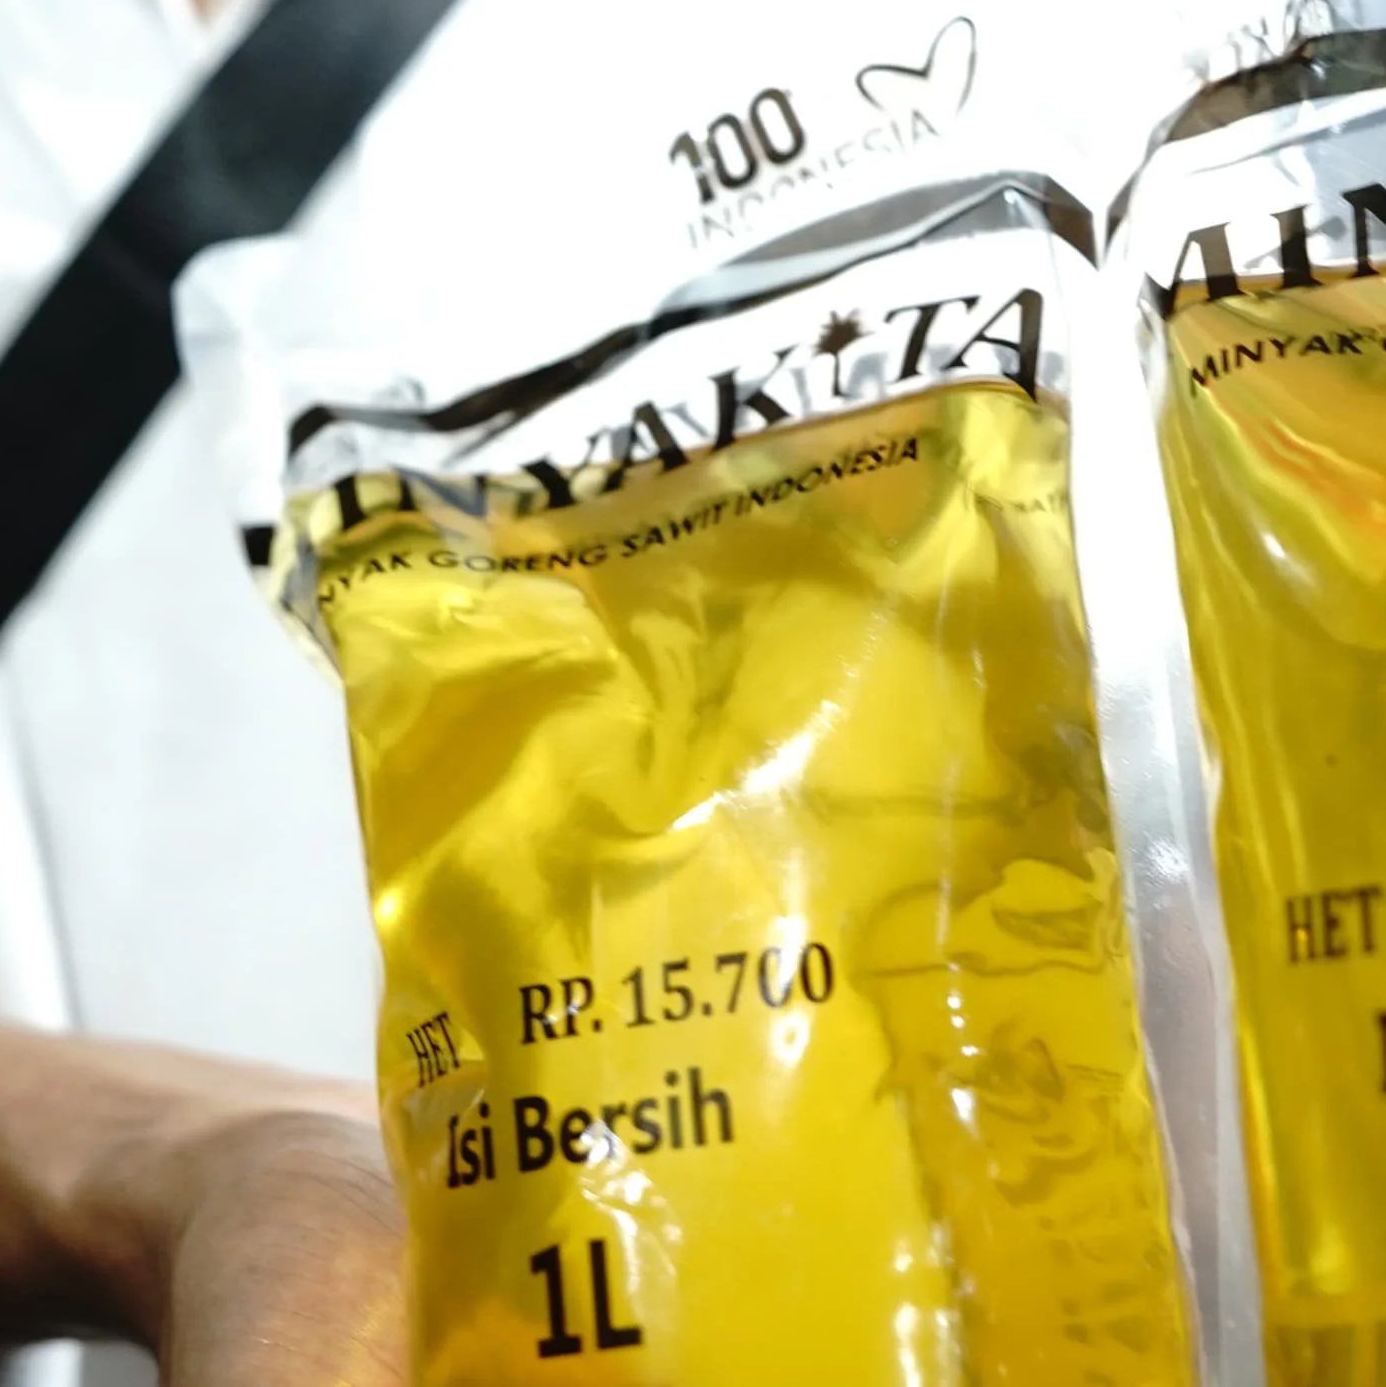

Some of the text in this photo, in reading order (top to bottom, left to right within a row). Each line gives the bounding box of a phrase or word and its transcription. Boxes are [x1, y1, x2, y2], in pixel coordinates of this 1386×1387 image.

[669, 87, 807, 205] 100
[1188, 330, 1366, 399] MINYAK
[317, 550, 414, 611] NYAK
[427, 542, 608, 573] GORENG
[619, 500, 728, 559] SAWIT
[733, 436, 922, 518] INDONESIA
[1285, 885, 1385, 964] HET
[406, 942, 834, 1089] HET RP. 15.700
[446, 1066, 734, 1189] Isi Bersih
[529, 1238, 643, 1360] 1L
